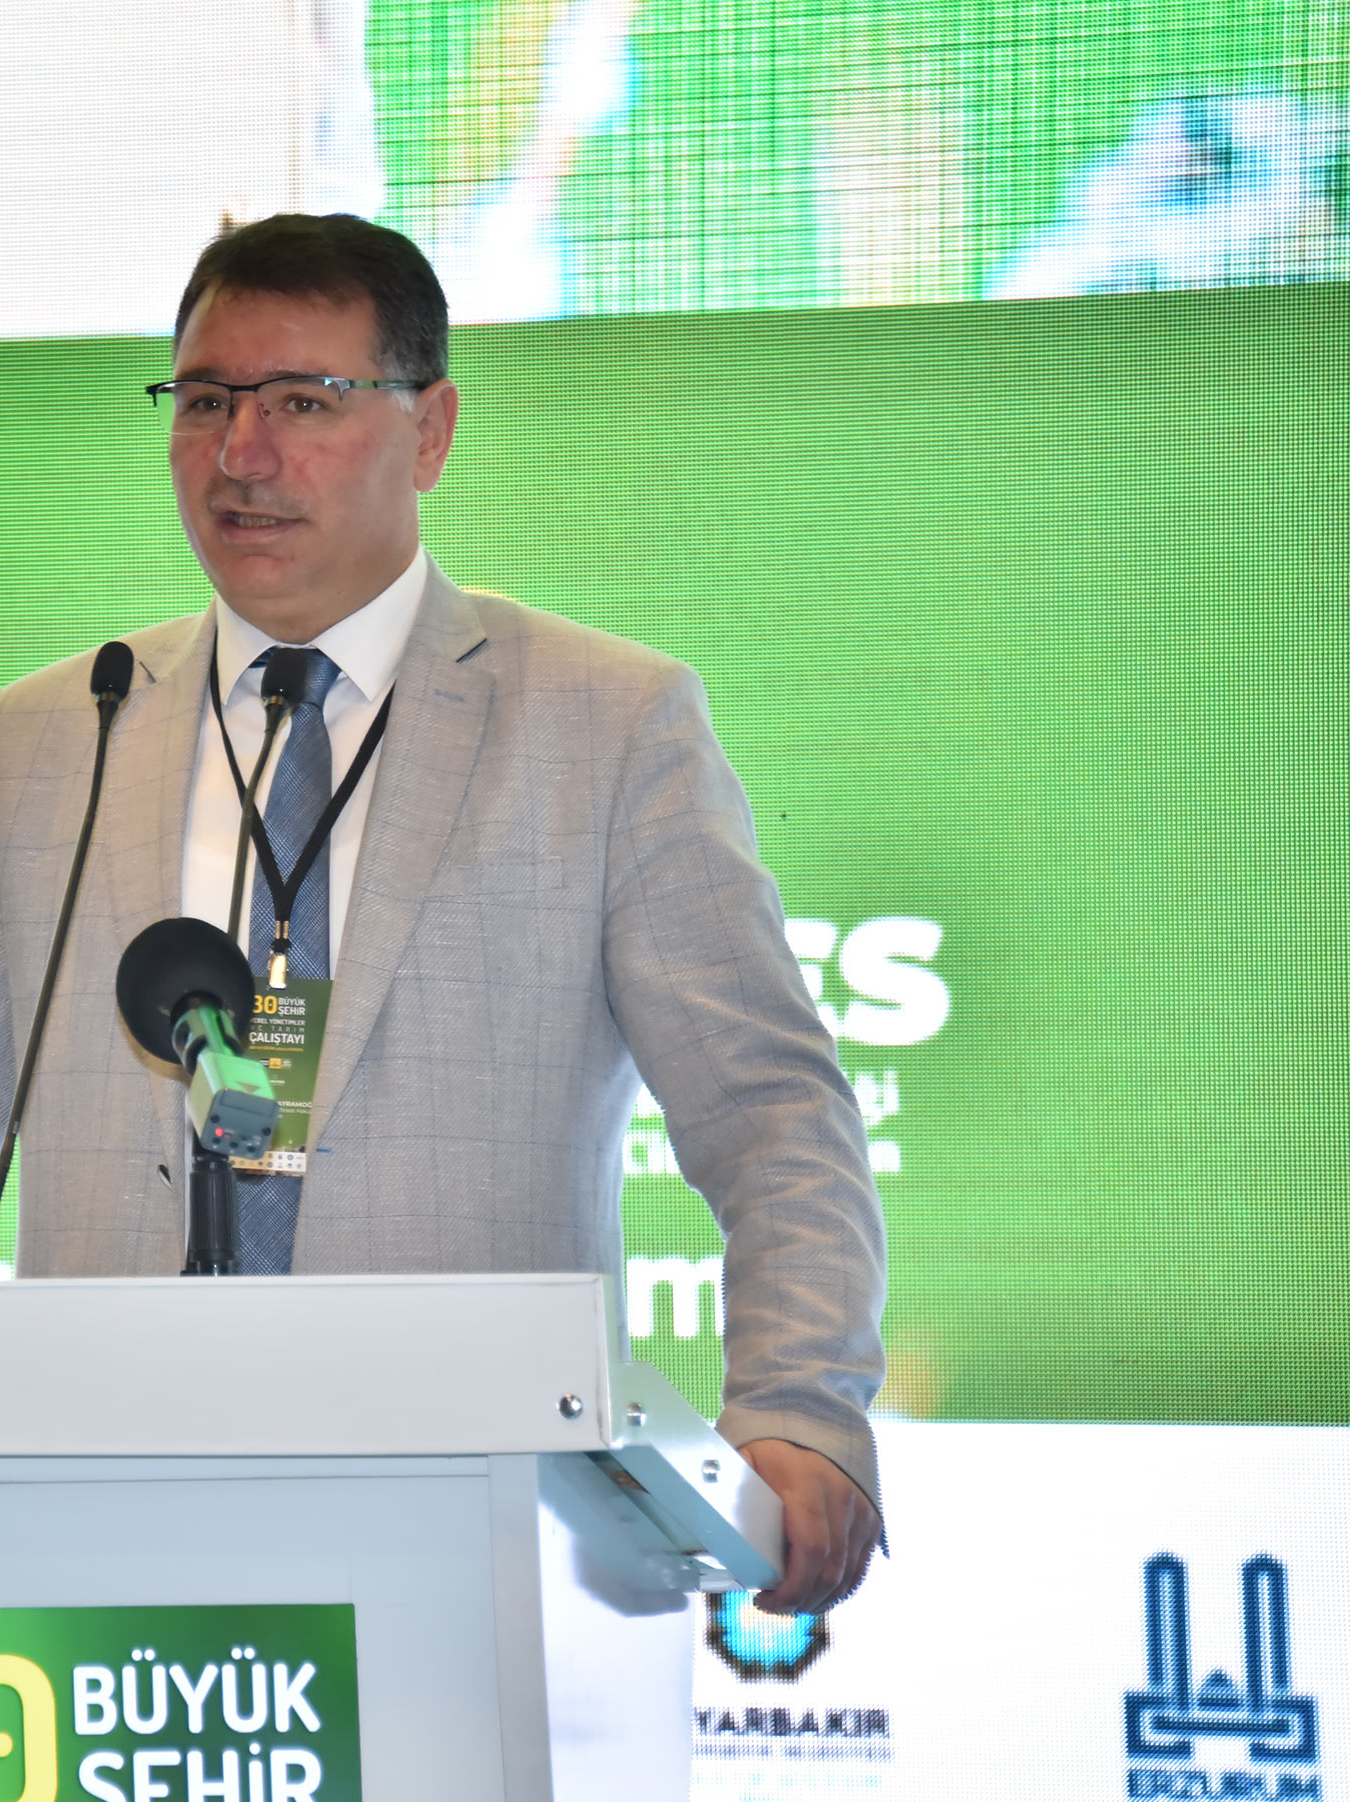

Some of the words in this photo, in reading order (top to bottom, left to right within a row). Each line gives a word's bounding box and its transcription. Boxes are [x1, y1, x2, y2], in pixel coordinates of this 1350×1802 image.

[252, 994, 278, 1015] 30
[278, 996, 306, 1006] BÜYÜK
[249, 1032, 305, 1046] ÇALIŞTAYI
[73, 1646, 321, 1736] BÜYÜK
[694, 1707, 890, 1737] YARBAKIR
